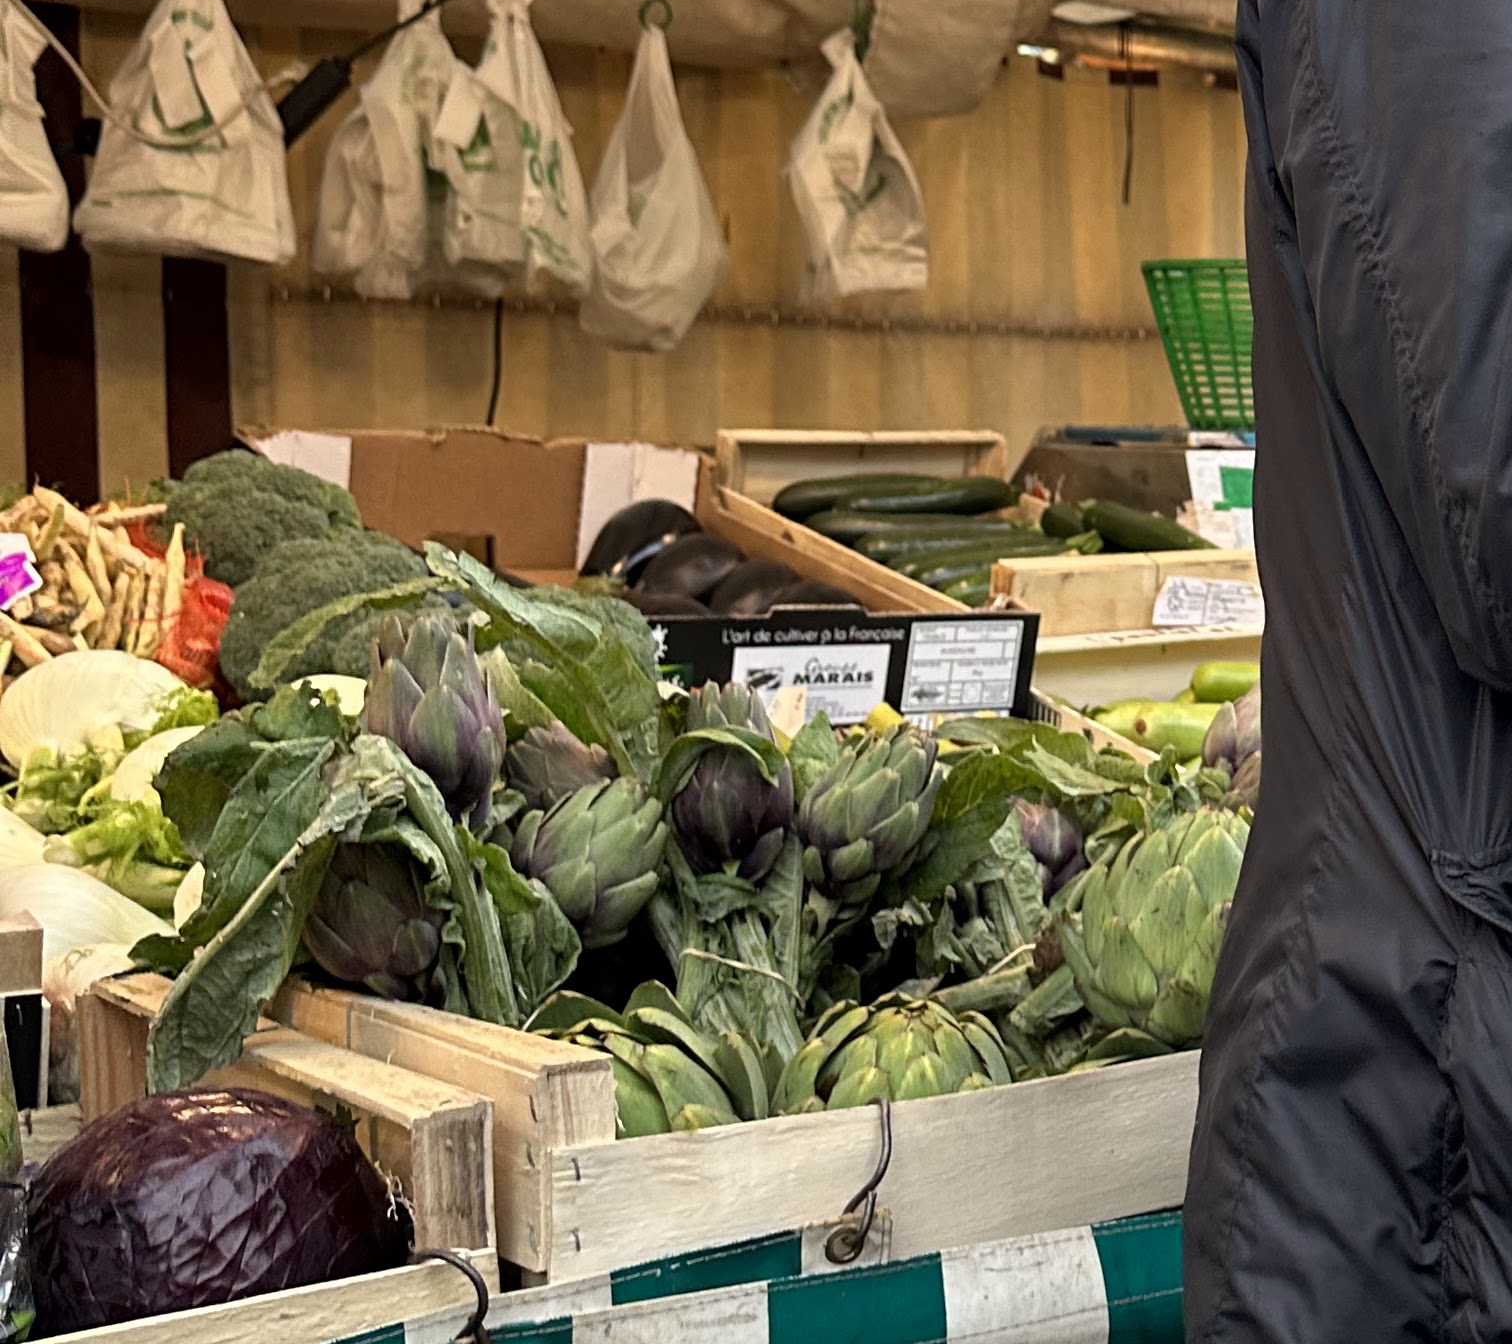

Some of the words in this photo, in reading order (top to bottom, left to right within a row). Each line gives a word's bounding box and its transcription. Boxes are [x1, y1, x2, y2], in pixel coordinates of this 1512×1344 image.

[753, 628, 771, 643] de
[774, 628, 819, 644] cultiver
[834, 626, 847, 641] la
[792, 670, 874, 685] MARAIS
